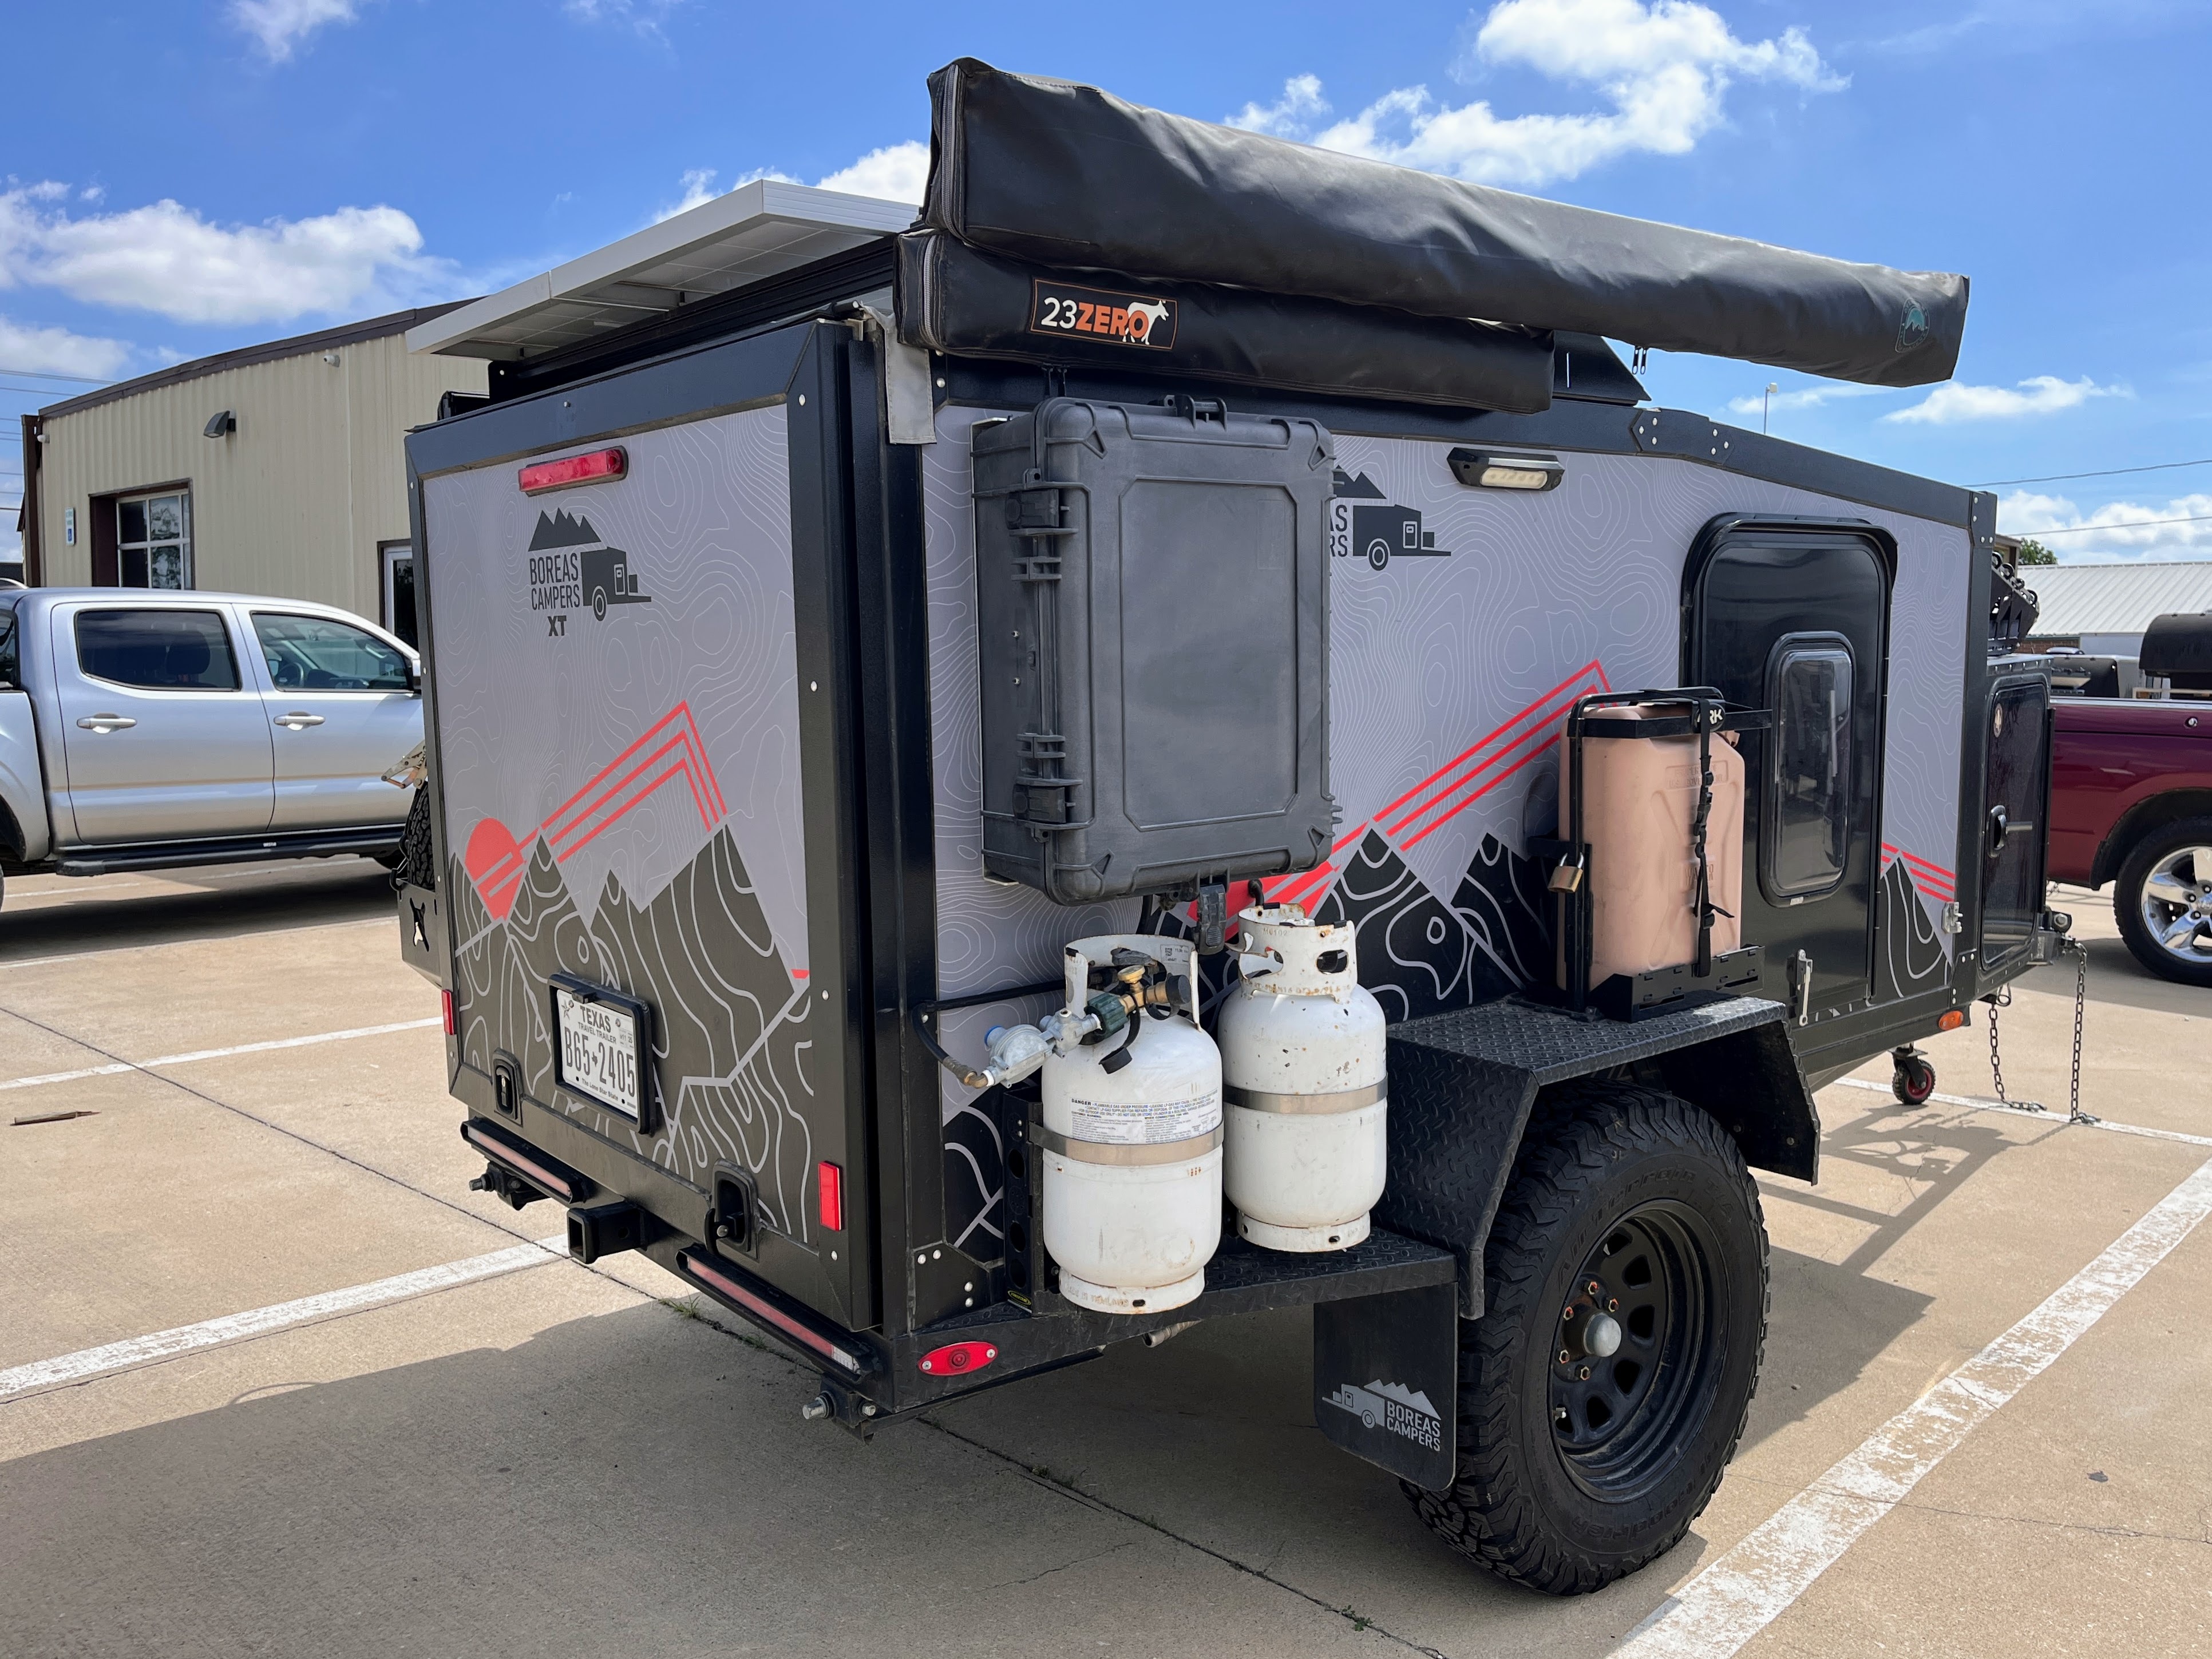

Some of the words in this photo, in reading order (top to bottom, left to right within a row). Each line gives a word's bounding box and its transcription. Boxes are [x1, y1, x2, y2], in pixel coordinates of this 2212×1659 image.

[1040, 296, 1149, 338] 23ZERO
[529, 553, 579, 585] BOREAS
[531, 584, 580, 611] CAMPERS
[548, 615, 567, 636] XT
[578, 1021, 596, 1036] TRAVEL
[596, 1030, 616, 1045] TRAILER
[580, 1005, 611, 1033] TEXAS
[598, 1042, 635, 1098] 2405
[589, 1082, 598, 1091] Lone
[608, 1091, 618, 1101] State
[1387, 1400, 1441, 1438] BOREAS
[1387, 1417, 1441, 1452] CAMPERS
